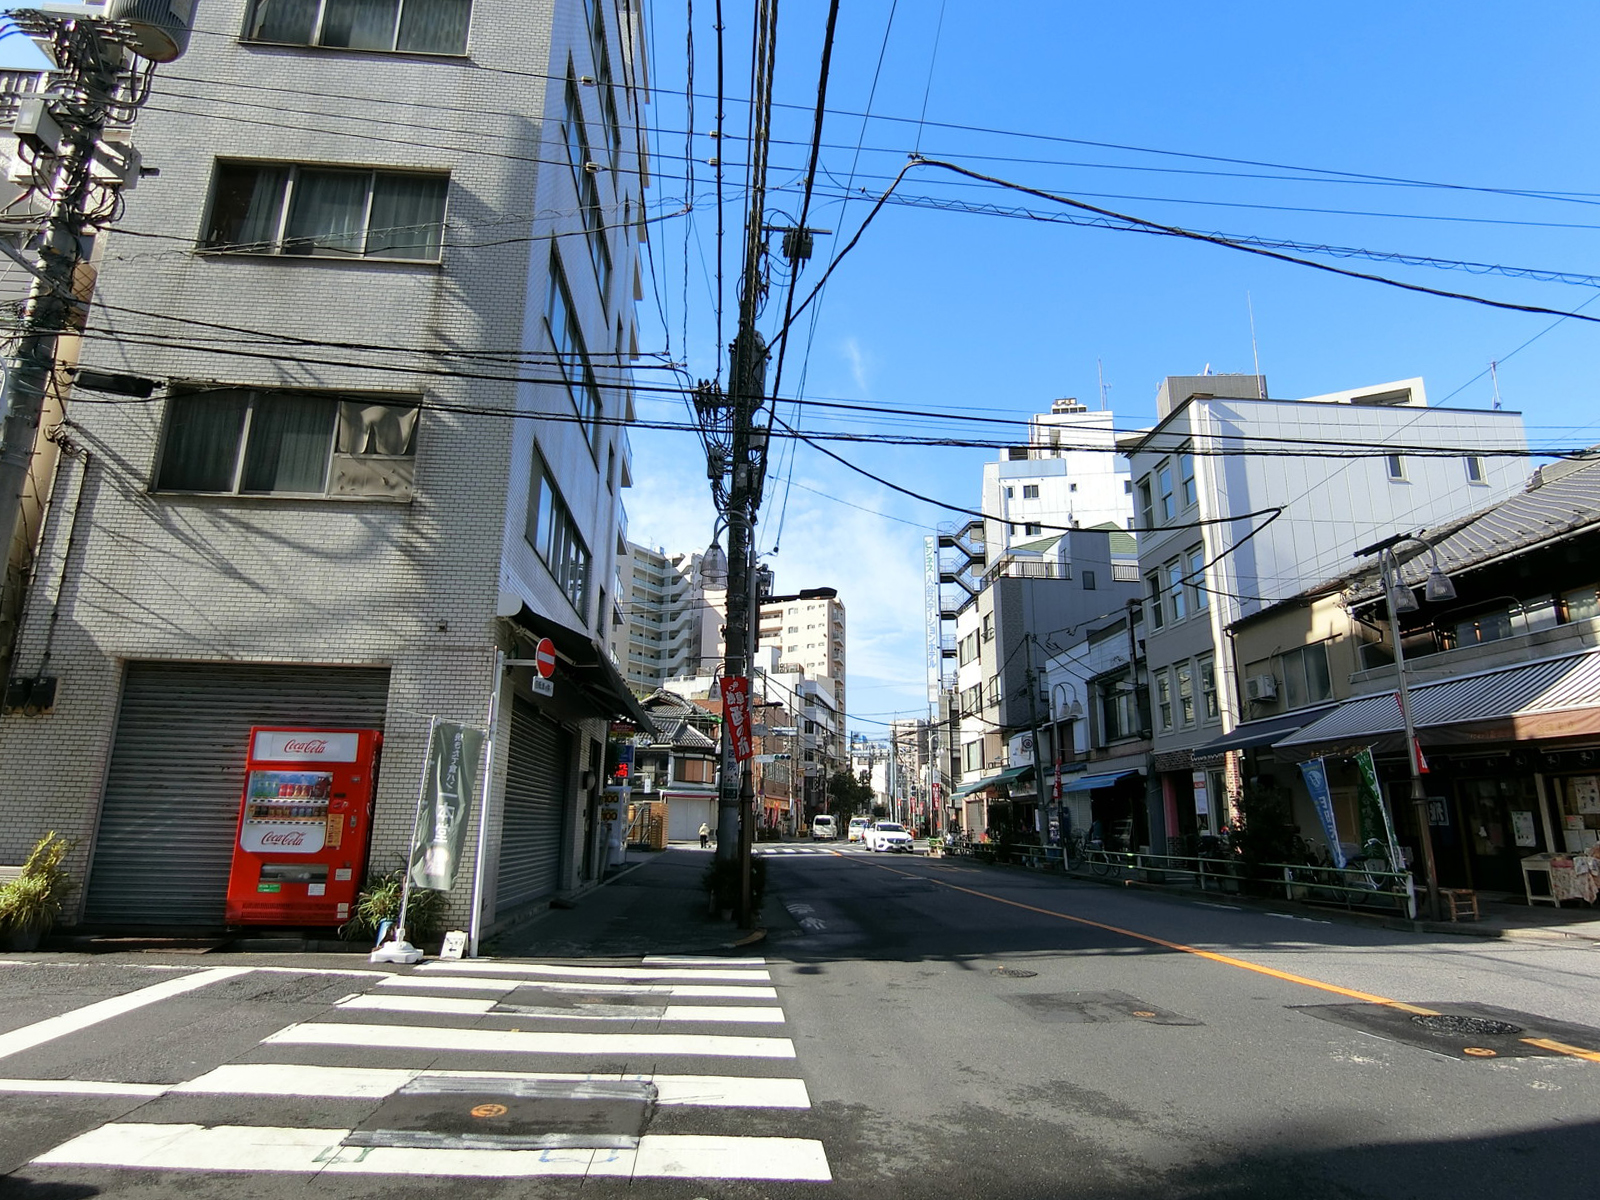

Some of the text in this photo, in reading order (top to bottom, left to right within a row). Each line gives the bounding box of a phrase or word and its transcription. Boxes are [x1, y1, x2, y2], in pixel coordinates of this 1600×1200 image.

[925, 540, 937, 669] ビジネス 入谷ステーションホテル
[284, 738, 328, 754] Coca-Cola
[261, 831, 307, 846] Coca-Cola
